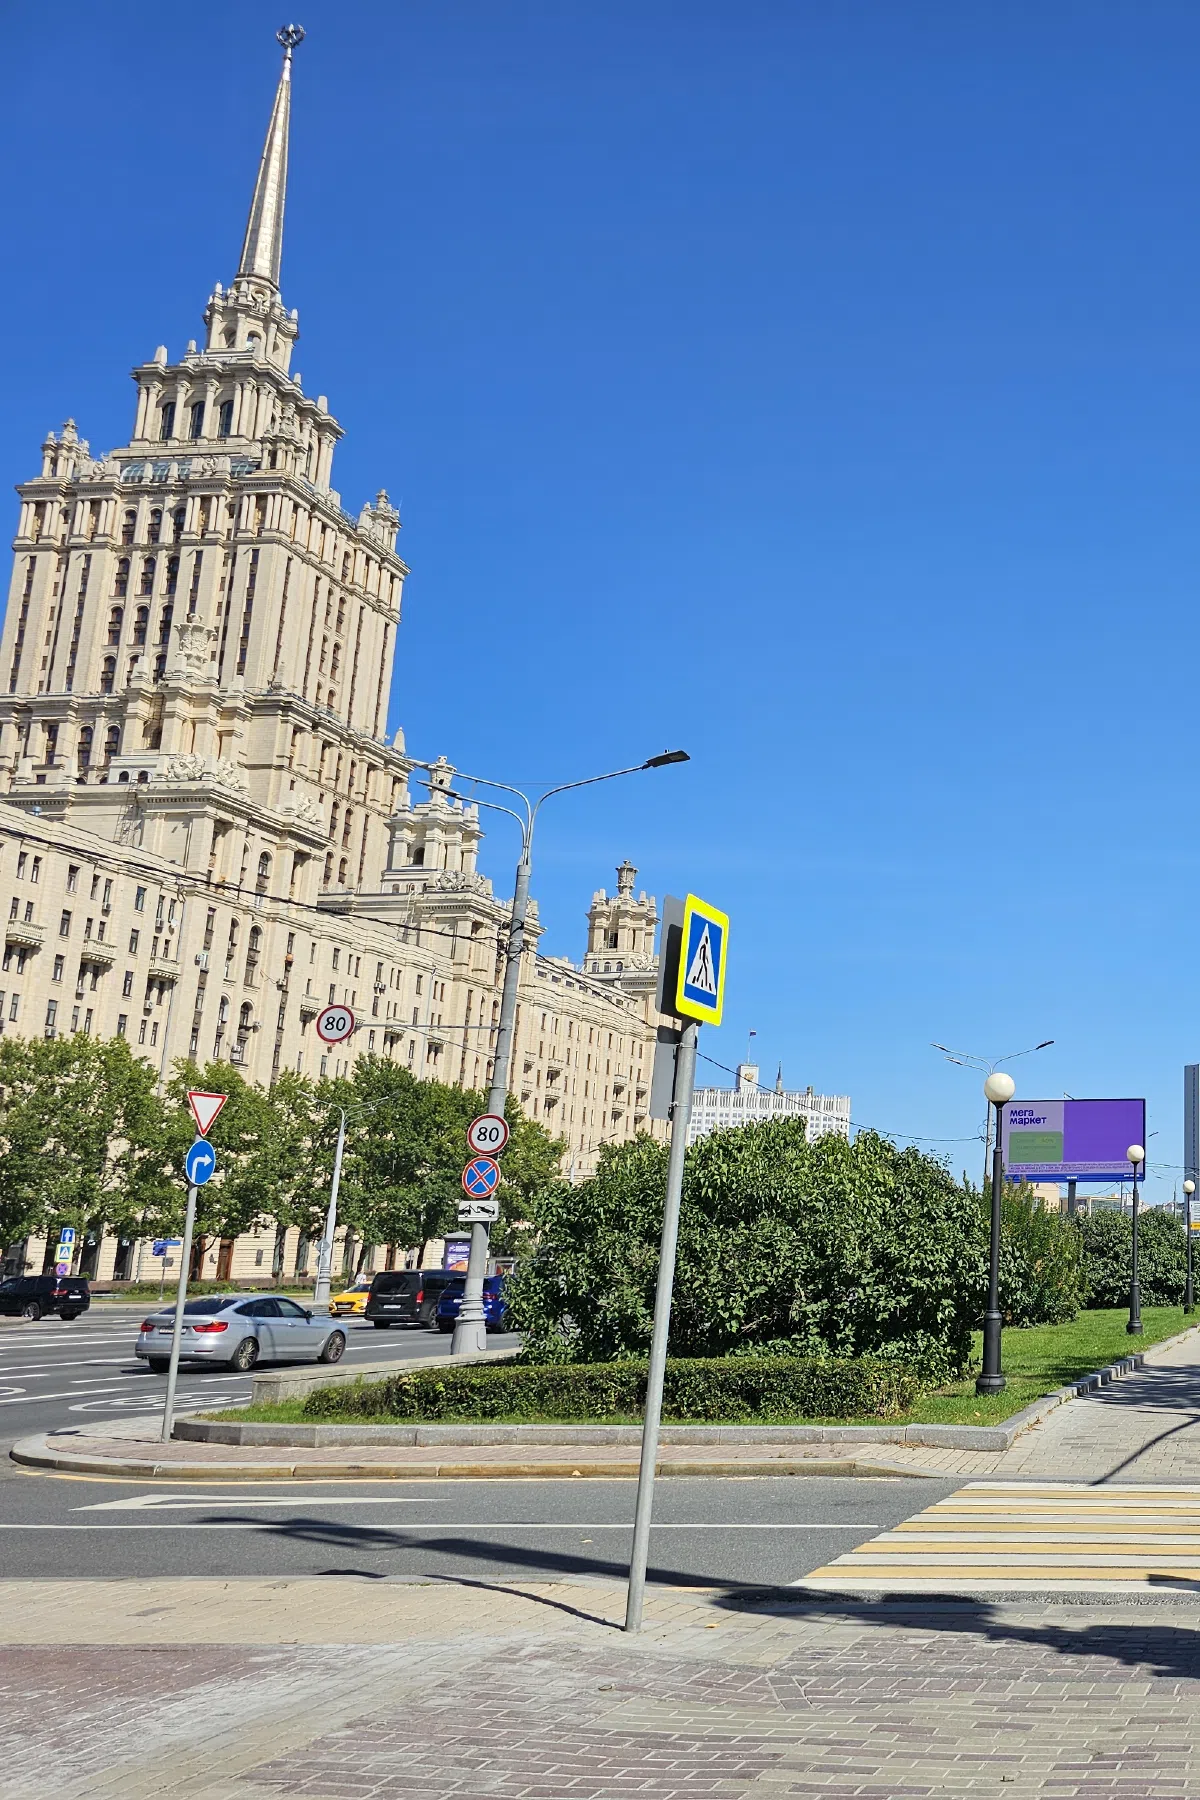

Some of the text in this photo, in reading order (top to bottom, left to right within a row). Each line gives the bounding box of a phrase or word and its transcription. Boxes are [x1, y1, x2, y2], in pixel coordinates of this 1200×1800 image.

[324, 1016, 346, 1031] 80
[1009, 1109, 1034, 1117] мега
[1009, 1117, 1047, 1126] маркет
[477, 1126, 500, 1142] 80
